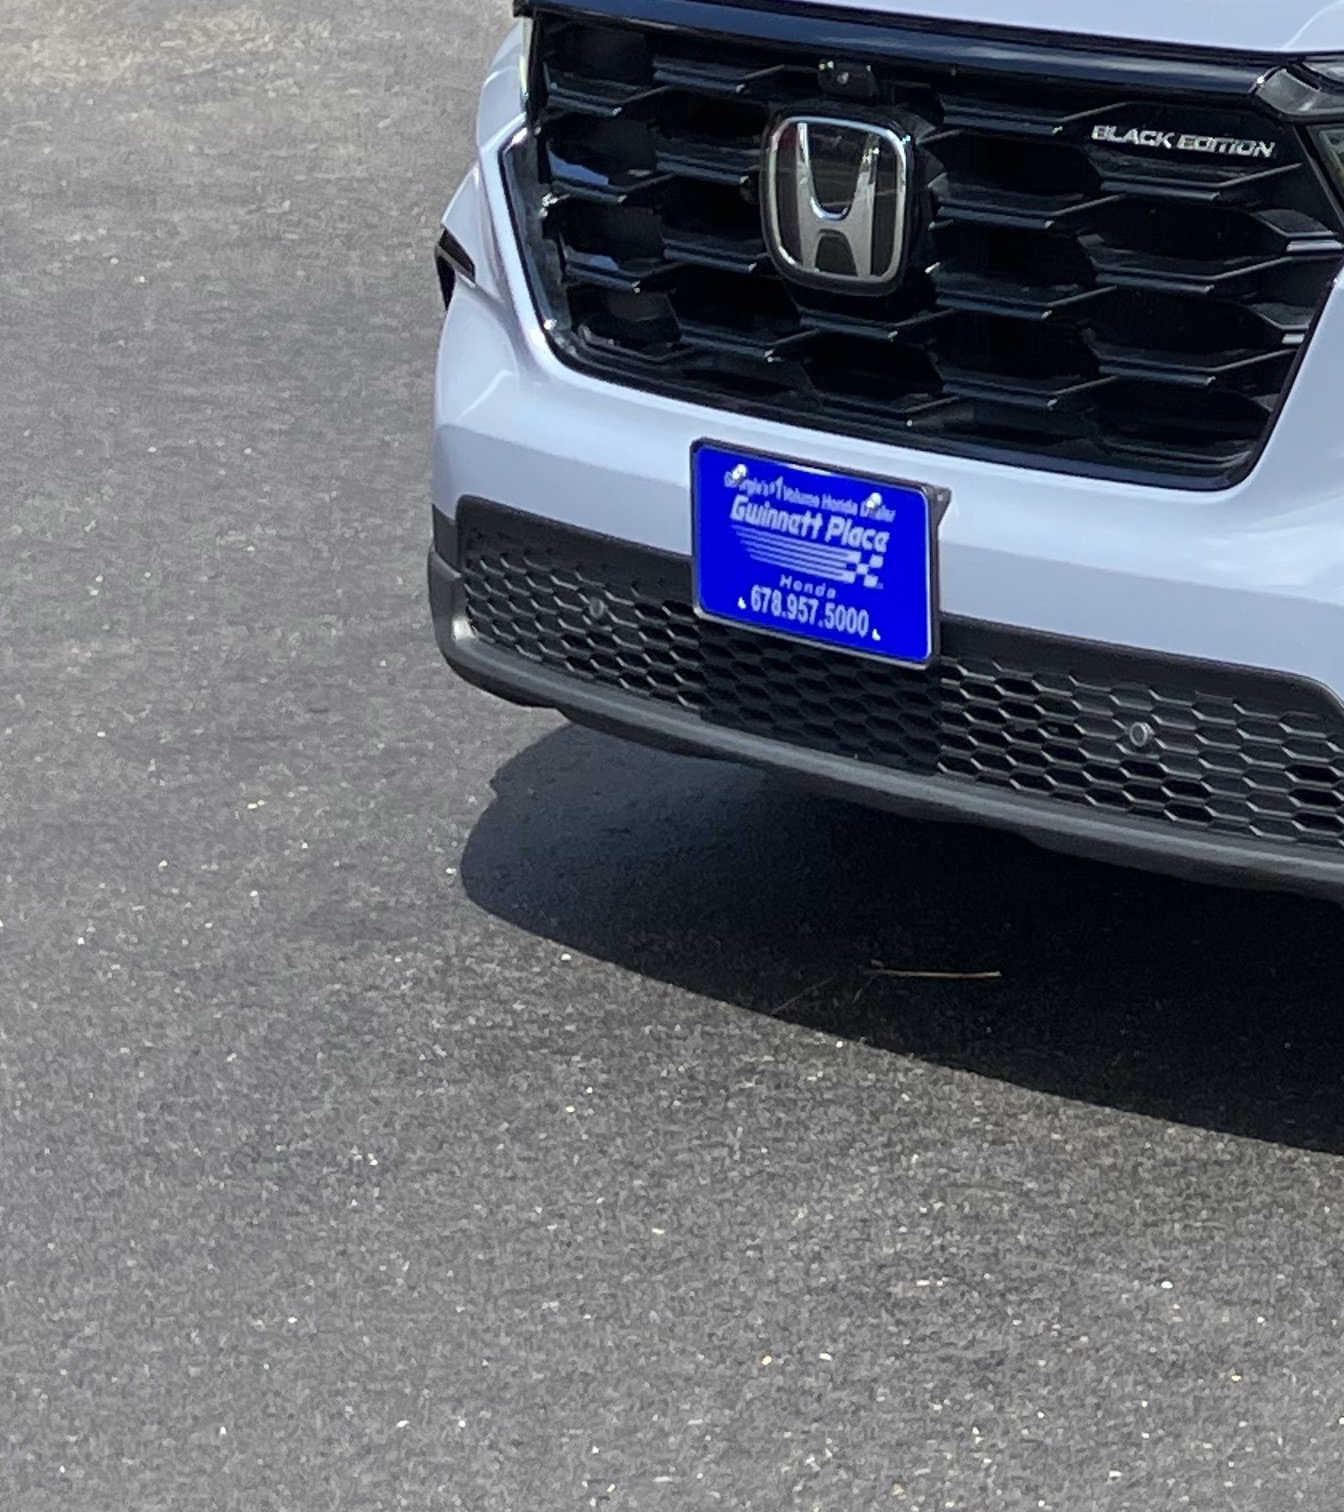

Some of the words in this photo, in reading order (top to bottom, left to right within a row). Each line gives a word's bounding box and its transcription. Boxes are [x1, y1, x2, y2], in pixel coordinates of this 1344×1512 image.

[1091, 125, 1174, 149] BLACK
[1176, 134, 1275, 158] EDITION
[821, 493, 858, 516] Honda
[730, 494, 823, 540] Gwinnett
[825, 514, 891, 553] Place
[779, 574, 837, 599] Honda
[751, 584, 869, 638] 678.957.5000
